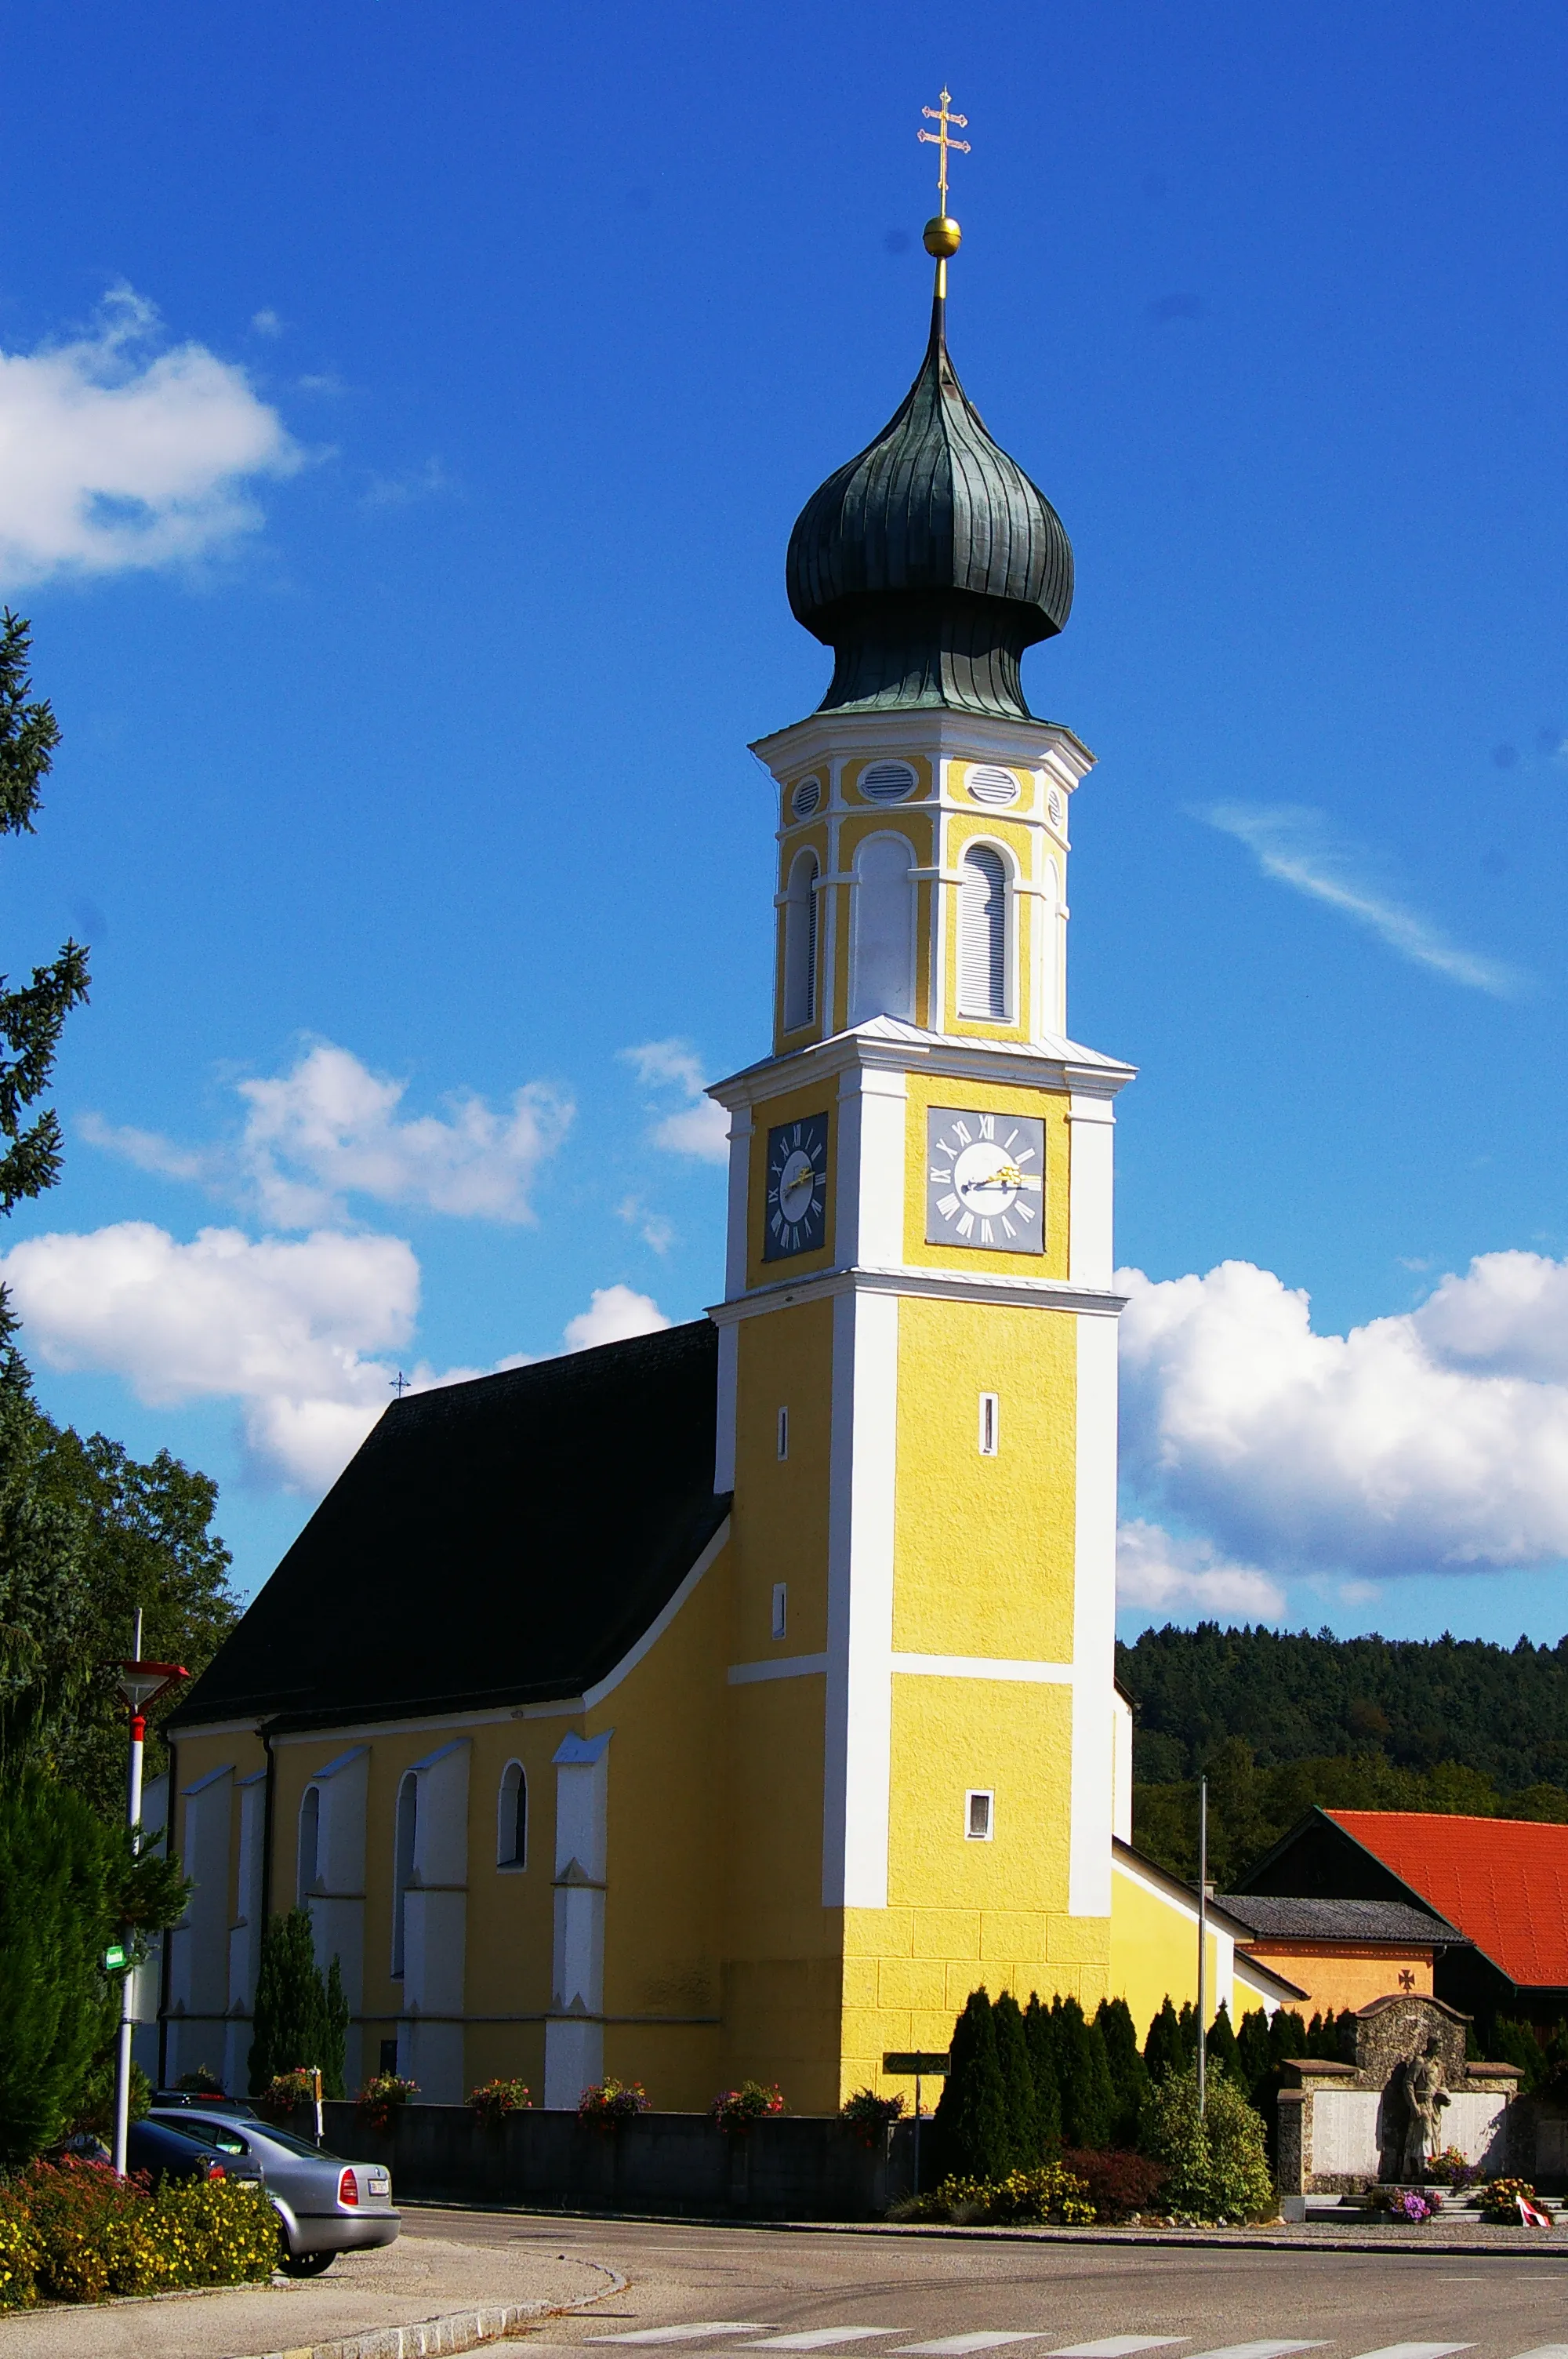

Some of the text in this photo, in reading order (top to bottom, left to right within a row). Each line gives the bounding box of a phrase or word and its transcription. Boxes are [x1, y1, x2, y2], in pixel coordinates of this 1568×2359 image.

[952, 1120, 972, 1147] XI
[978, 1114, 994, 1140] XII
[1004, 1129, 1018, 1148] I
[936, 1138, 957, 1161] X
[1014, 1148, 1036, 1164] II
[771, 1161, 782, 1176] X
[931, 1166, 951, 1183] IX
[768, 1187, 779, 1203] IX
[936, 1193, 960, 1221] VIII
[1014, 1200, 1035, 1223] IV
[956, 1211, 975, 1238] VII
[982, 1219, 994, 1243] VI
[1002, 1216, 1017, 1238] V
